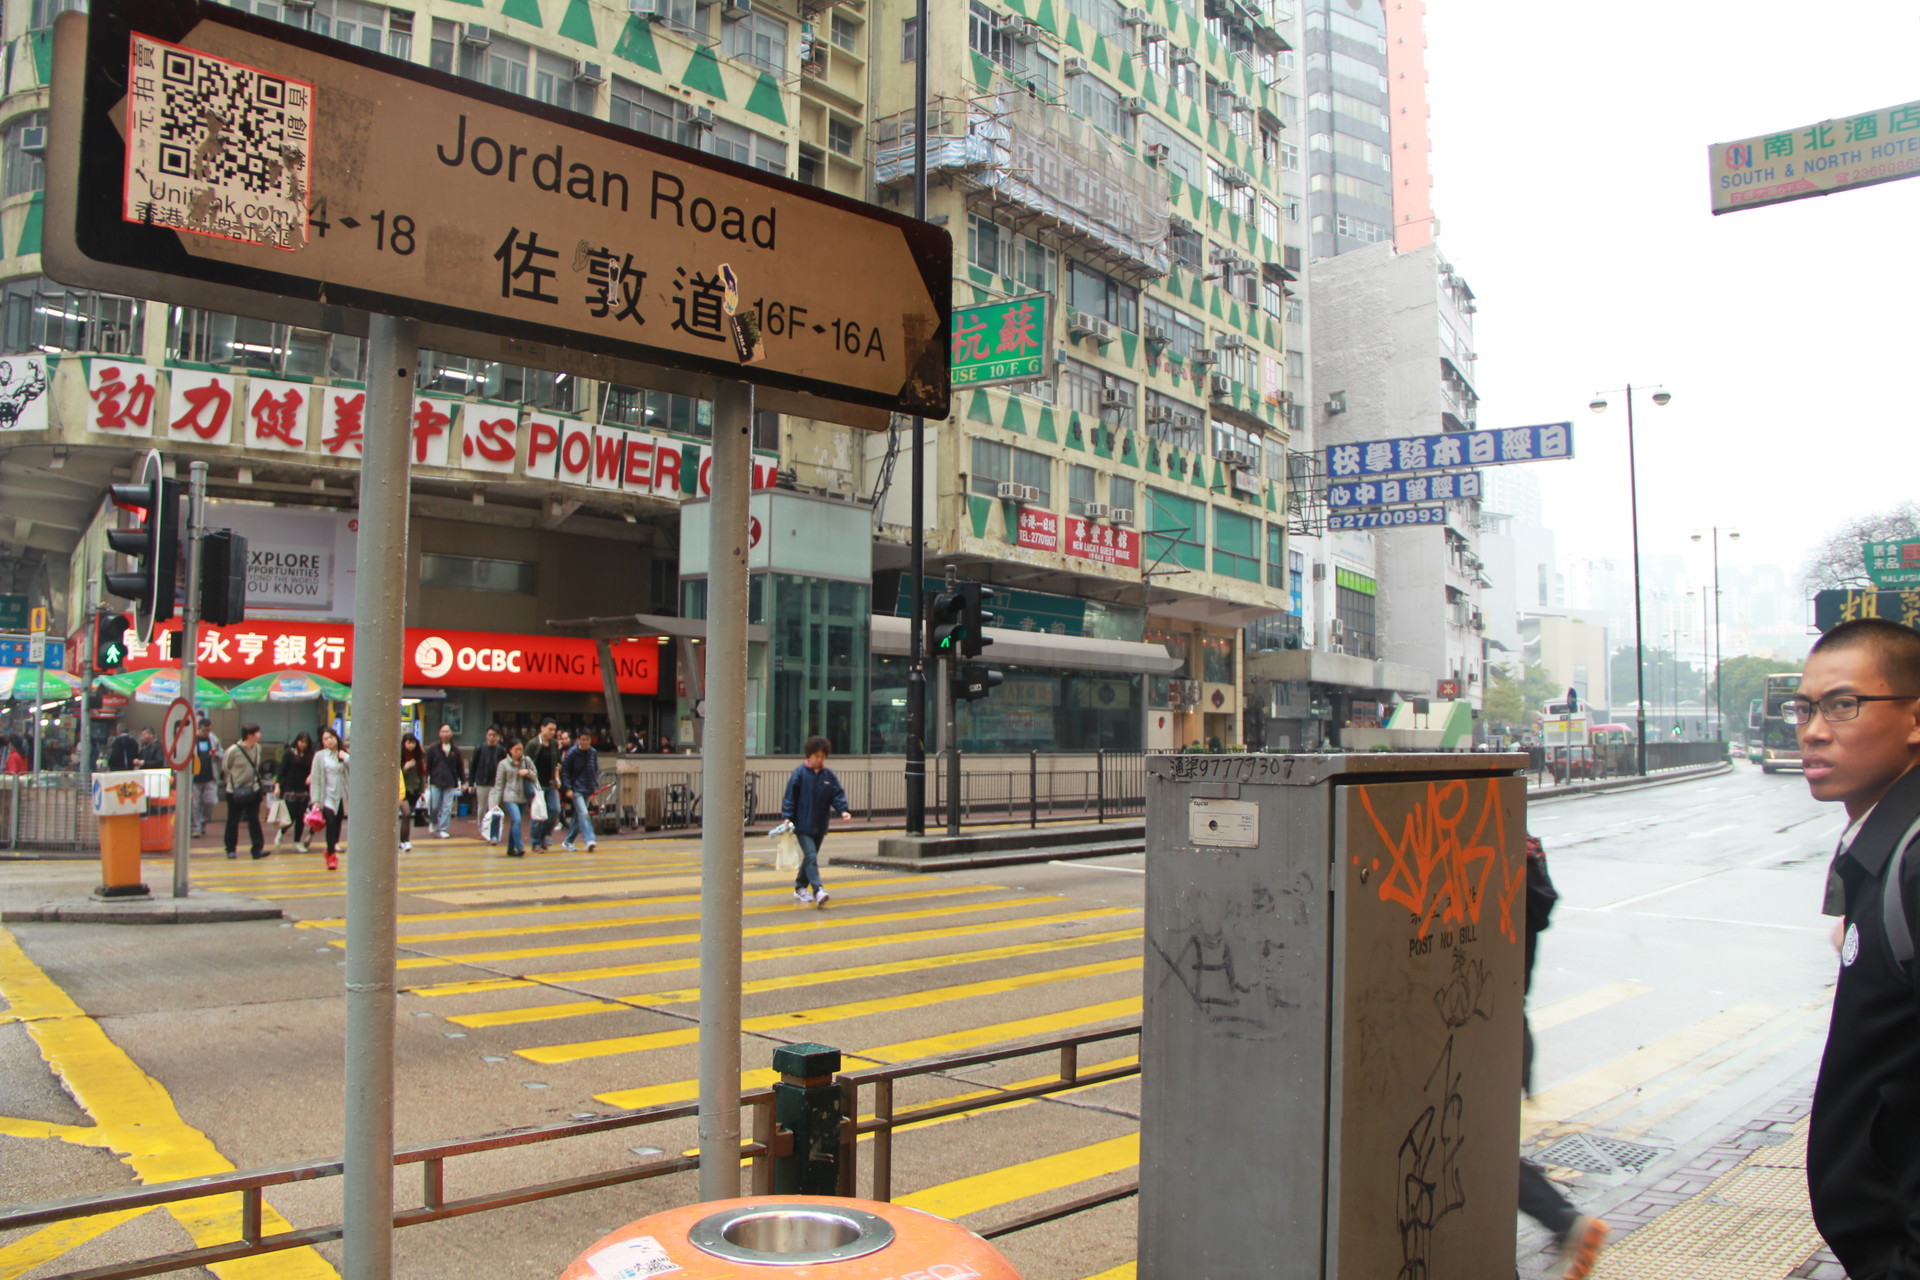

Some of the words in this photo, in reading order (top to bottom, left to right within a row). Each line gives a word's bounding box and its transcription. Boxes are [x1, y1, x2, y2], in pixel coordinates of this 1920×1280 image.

[1764, 105, 1920, 160] 南北酒店
[436, 114, 629, 213] Jordan
[651, 170, 776, 250] Road
[1720, 167, 1774, 189] SOUTH
[1784, 164, 1794, 177] &
[1804, 149, 1861, 174] NORTH
[494, 226, 726, 343] 佐敦道
[89, 366, 517, 463] 勁力健美中心
[528, 423, 682, 493] POWER
[1344, 507, 1443, 528] 27700993
[247, 551, 319, 569] XPLORE
[1073, 542, 1084, 551] NEW
[1083, 542, 1100, 553] LUCKY
[1100, 545, 1115, 556] GUEST
[1115, 548, 1130, 560] HOUSE
[274, 583, 319, 595] KNOW
[275, 575, 288, 583] THE
[457, 646, 521, 674] OCBC
[524, 651, 586, 676] WING
[1409, 934, 1434, 957] POST
[1459, 925, 1478, 944] BILL
